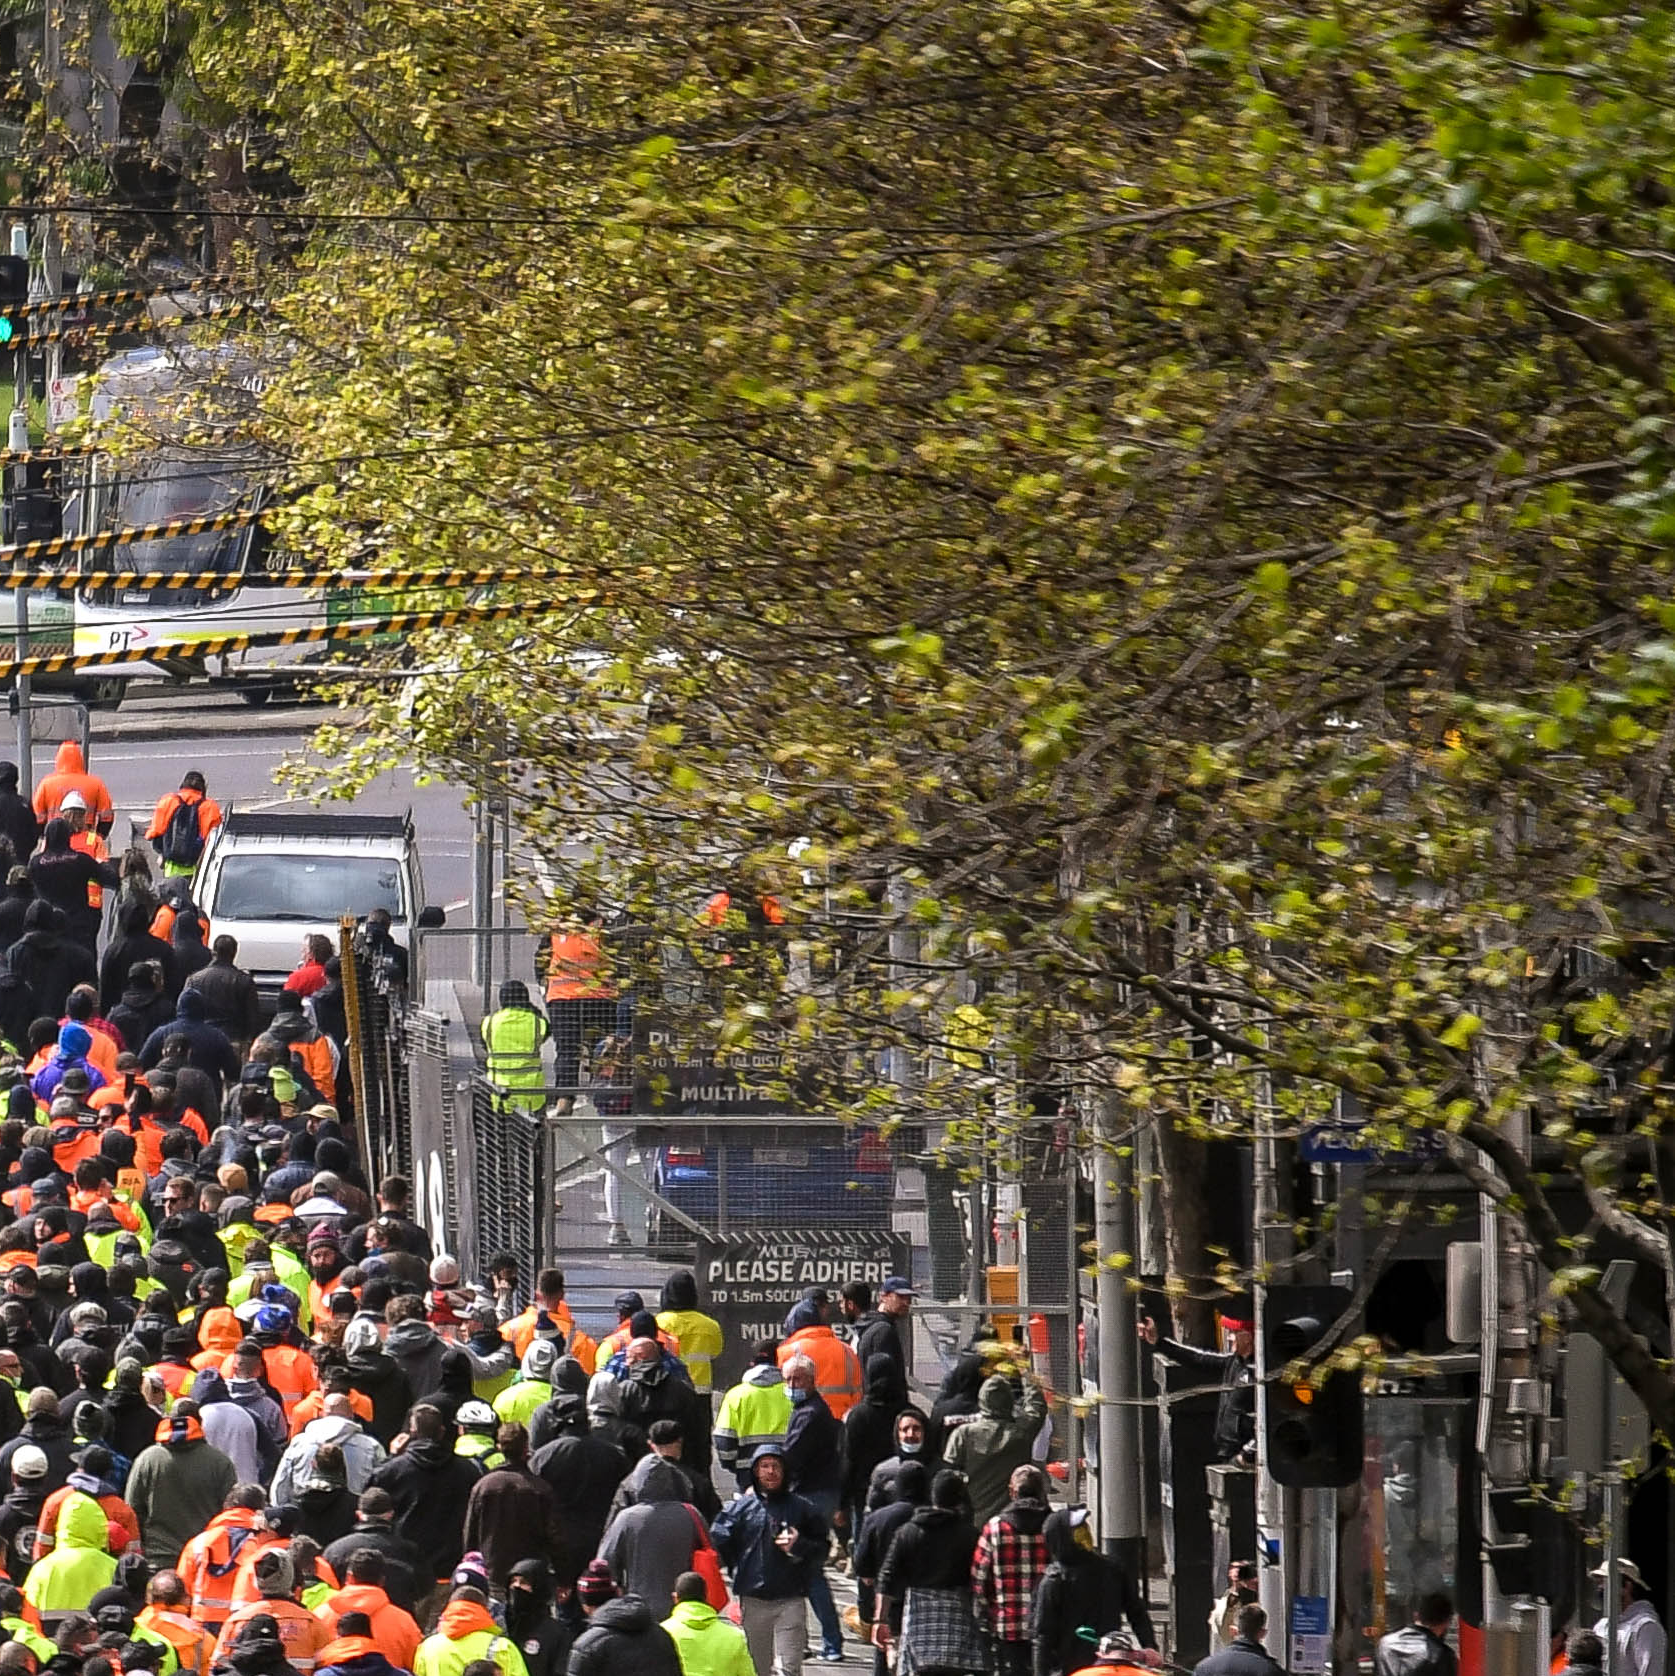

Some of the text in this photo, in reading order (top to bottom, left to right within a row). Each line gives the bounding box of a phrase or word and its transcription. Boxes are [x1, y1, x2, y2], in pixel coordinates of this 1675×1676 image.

[708, 1261, 894, 1283] PLEASE ADHERE
[711, 1290, 727, 1303] TO
[731, 1290, 763, 1303] 1.5m
[765, 1289, 809, 1303] SOCIA
